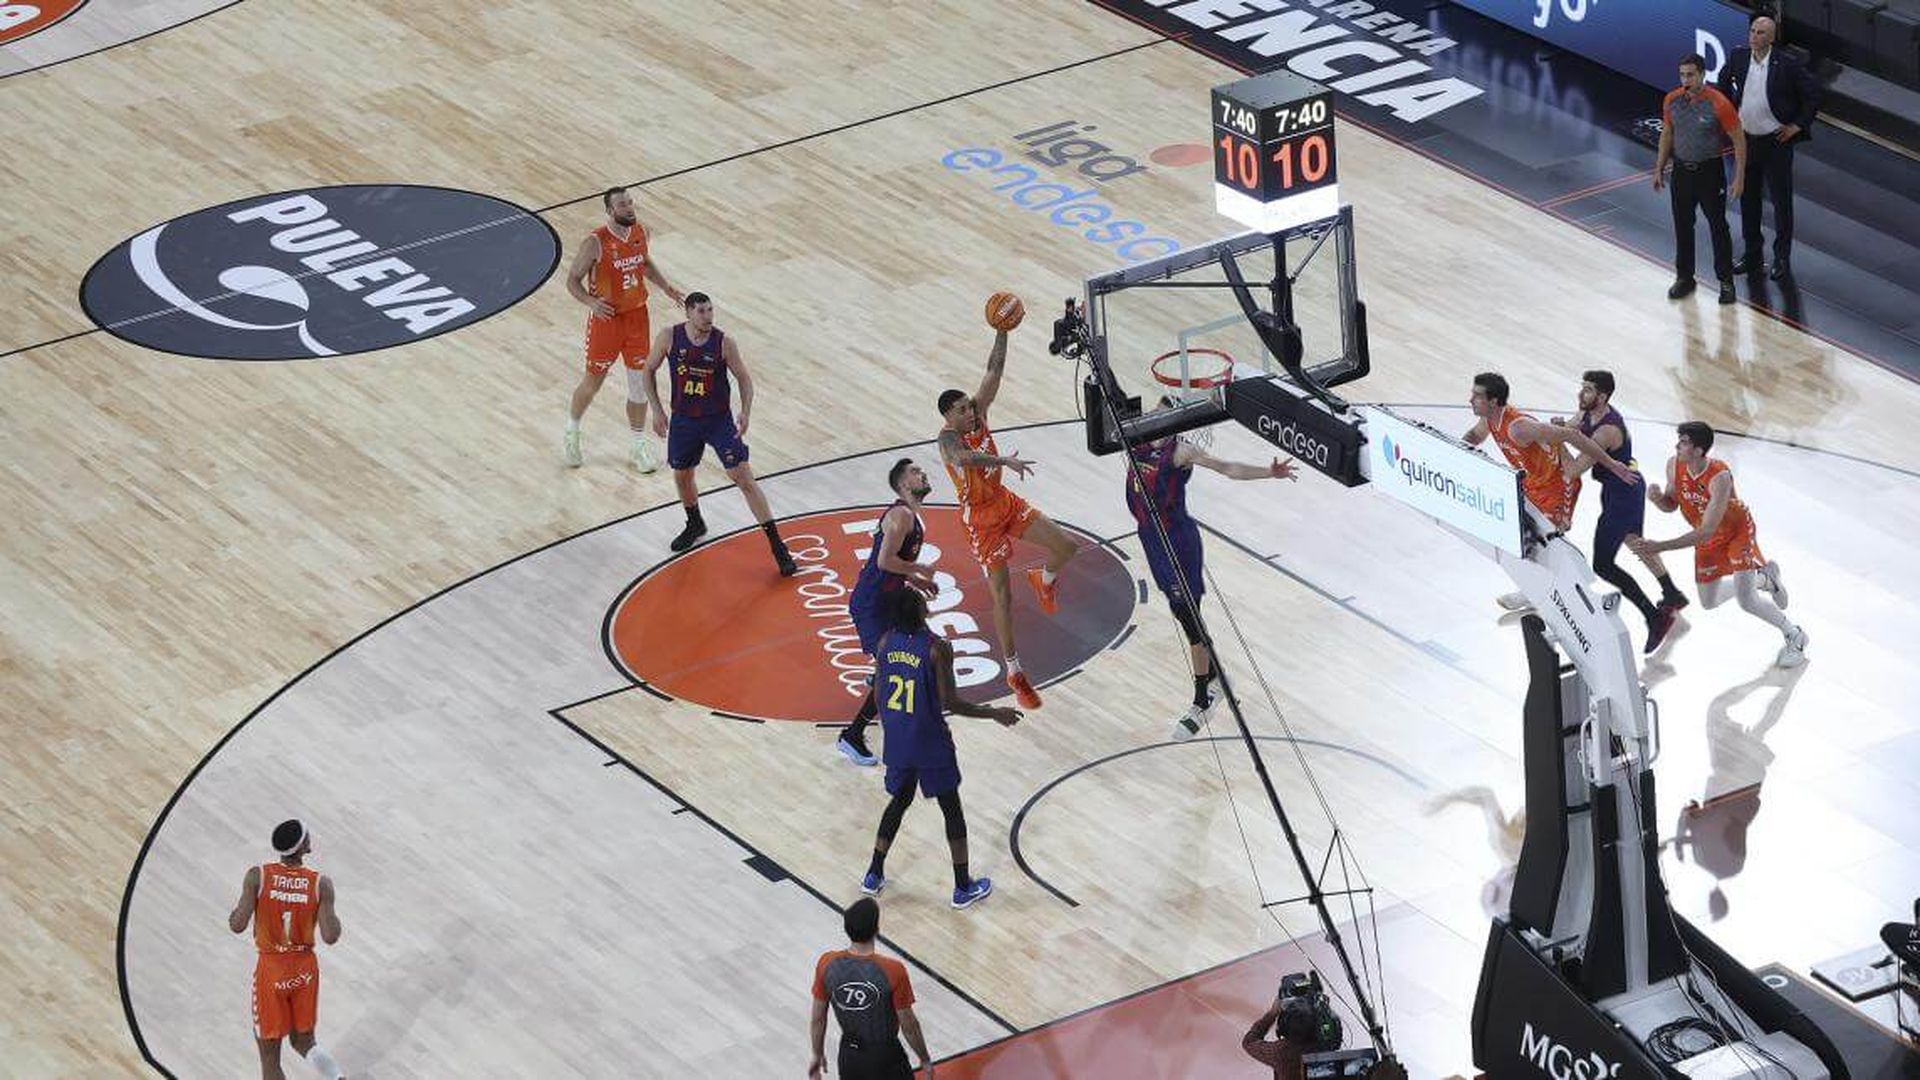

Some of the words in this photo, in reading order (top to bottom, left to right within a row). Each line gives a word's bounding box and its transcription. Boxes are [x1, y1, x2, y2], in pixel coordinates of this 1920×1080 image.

[1306, 0, 1459, 56] RENA
[1144, 0, 1485, 122] ENCIA
[1221, 100, 1256, 134] 7:40
[1275, 100, 1326, 133] 7:40
[1013, 120, 1149, 182] liga
[1220, 134, 1258, 189] 10
[1273, 135, 1328, 189] 10
[227, 194, 476, 334] PULEVA
[684, 381, 706, 396] 44
[1258, 414, 1329, 467] endesa
[1550, 589, 1592, 653] SPALDING
[887, 674, 915, 713] 21
[272, 875, 309, 890] TAYLOR
[281, 911, 292, 943] 1
[843, 987, 867, 1005] 79
